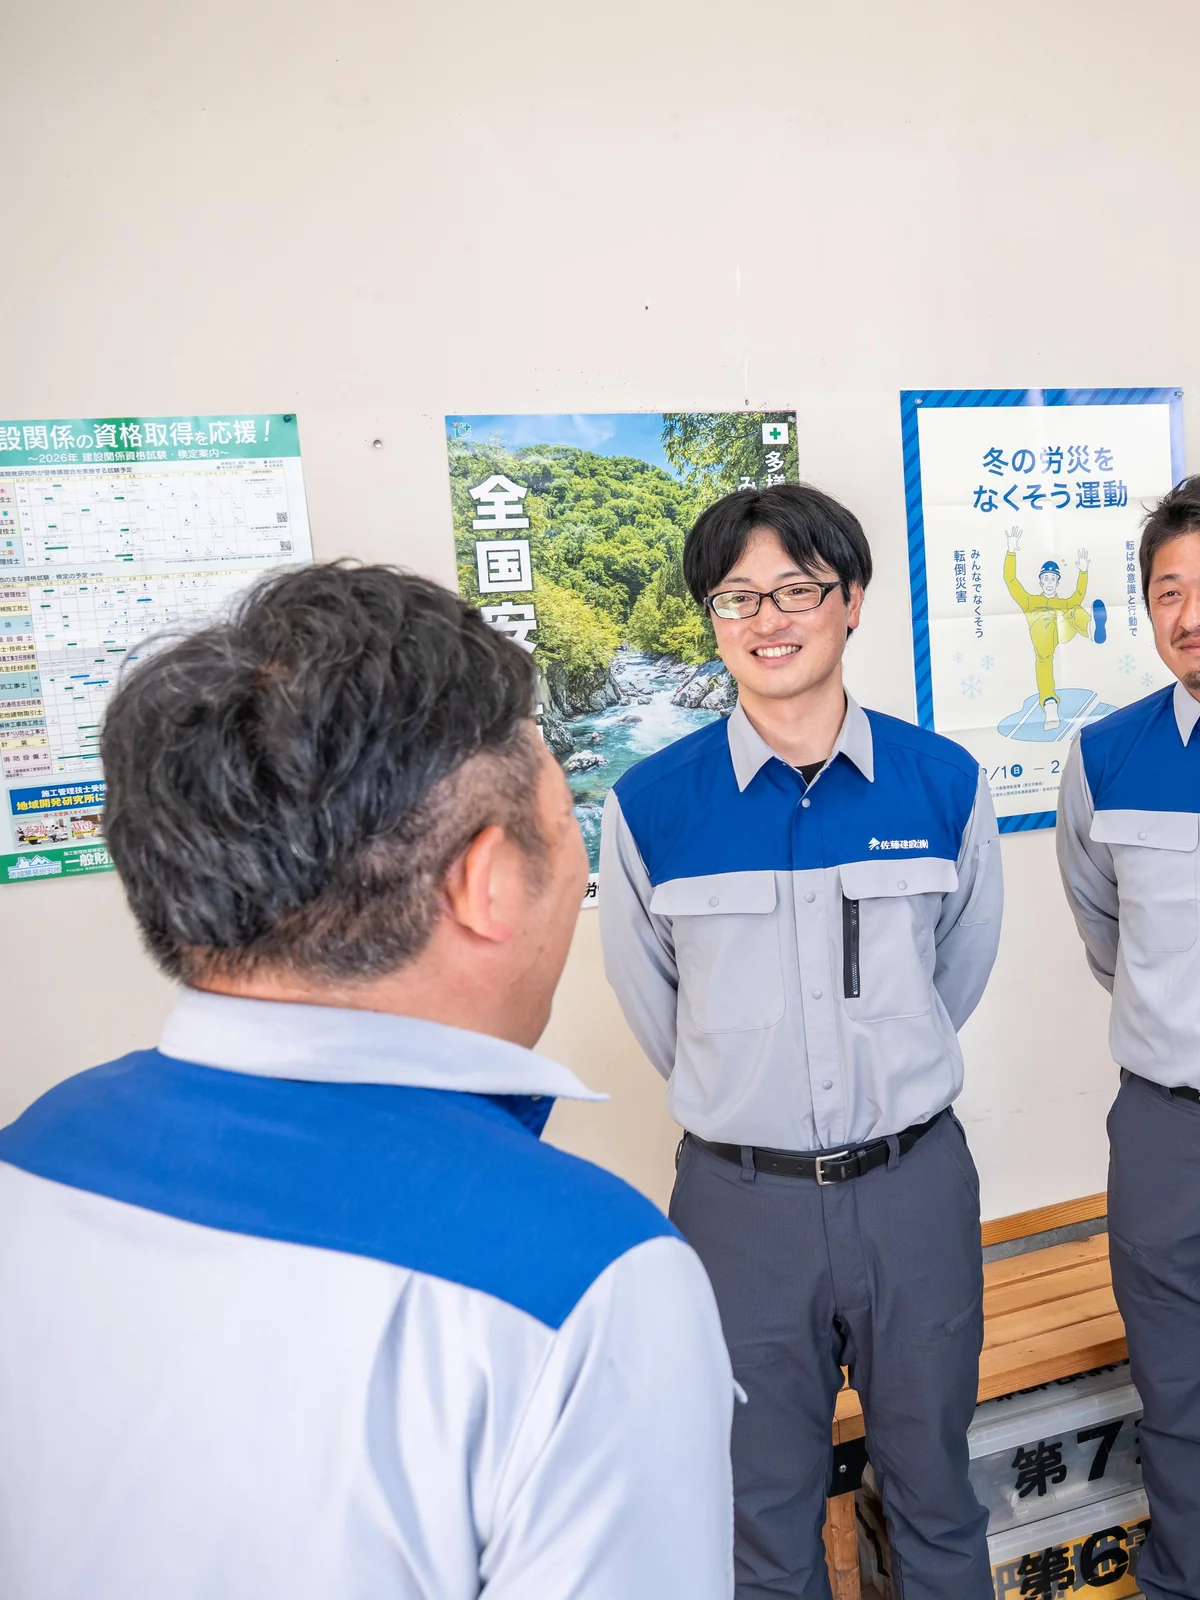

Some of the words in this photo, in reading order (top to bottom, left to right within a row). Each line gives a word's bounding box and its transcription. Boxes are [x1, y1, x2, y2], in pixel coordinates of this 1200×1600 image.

[983, 444, 1114, 476] 冬の労災を
[973, 479, 1128, 513] なくそう運動
[953, 550, 967, 603] 転倒災害
[970, 549, 984, 638] みんなでなくそう
[1125, 540, 1138, 636] 転ばぬ意識と行動で
[584, 882, 599, 898] 労
